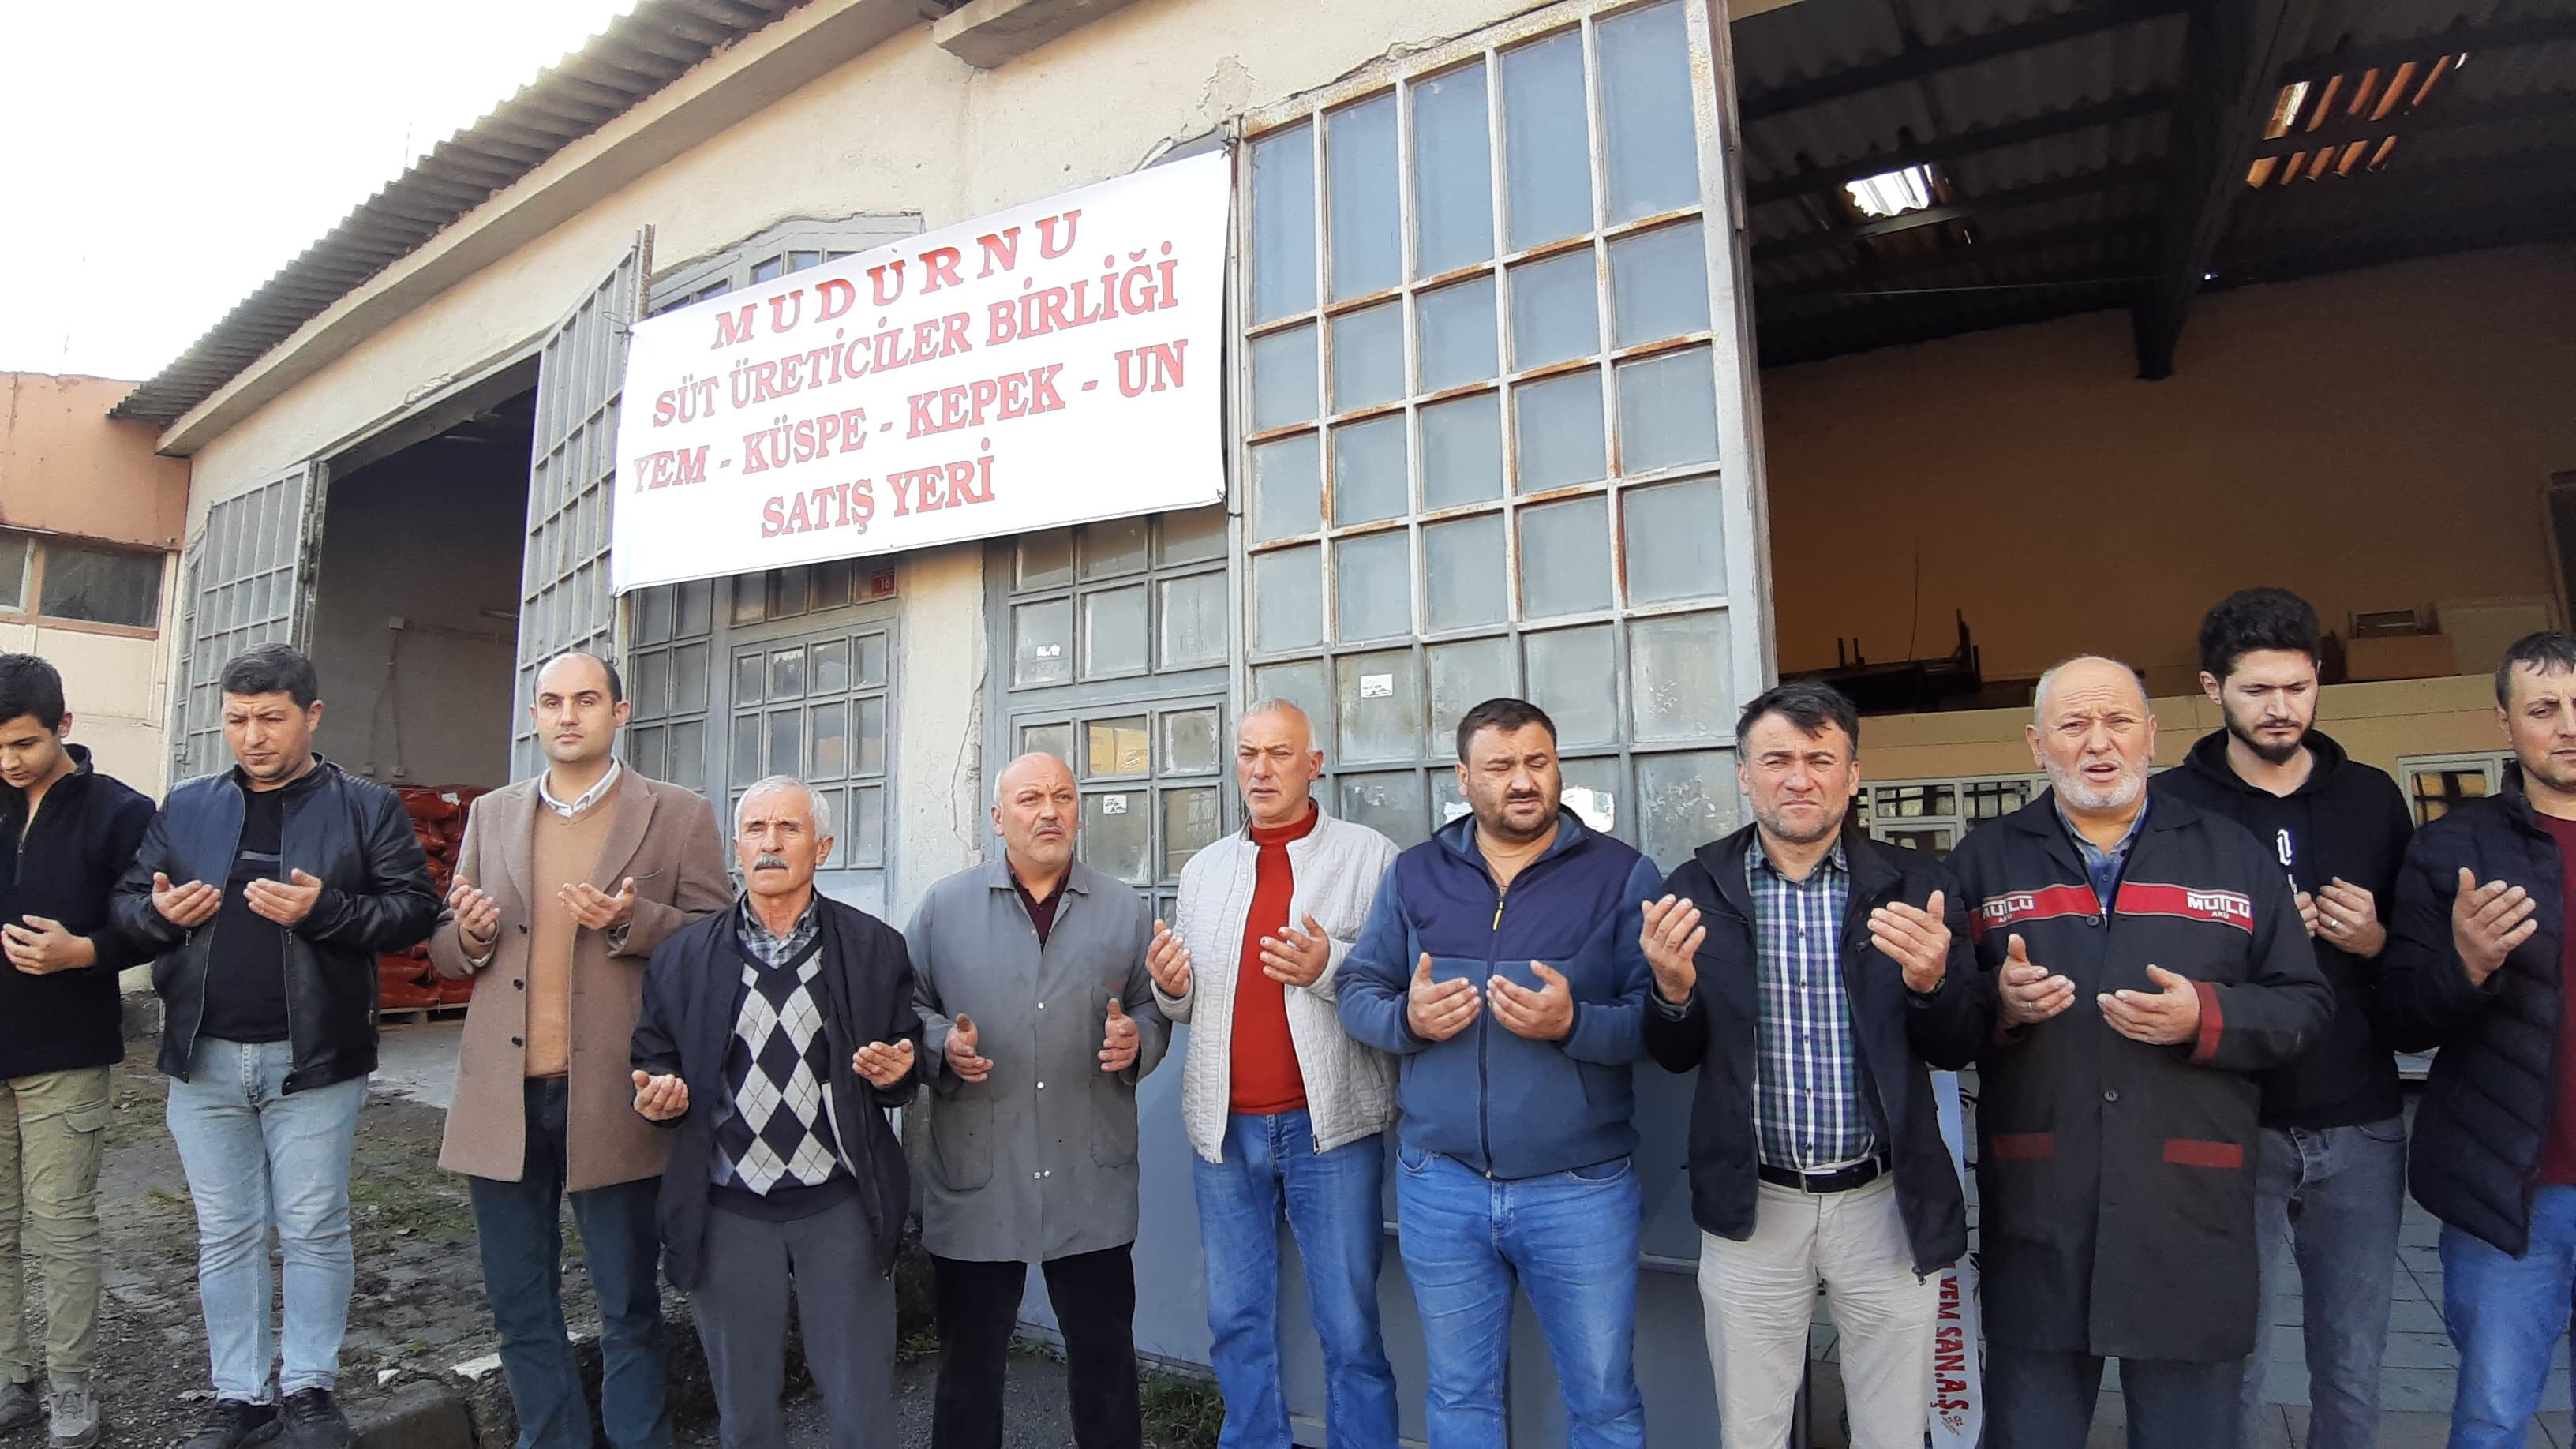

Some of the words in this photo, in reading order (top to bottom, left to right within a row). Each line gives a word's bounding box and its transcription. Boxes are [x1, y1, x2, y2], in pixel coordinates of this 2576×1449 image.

[653, 373, 719, 428] SÜT
[731, 312, 972, 410] ÜRETİCİLER
[987, 241, 1179, 346] BİRLİĞİ
[711, 210, 1082, 350] MUDURNU
[634, 444, 708, 495] YEM
[743, 408, 867, 475] KÜSPE
[907, 364, 1066, 440] KEPEK
[1115, 339, 1189, 399] UN
[761, 479, 875, 539] SATIŞ
[886, 438, 995, 518] YERİ
[2186, 891, 2250, 919] MUTLU
